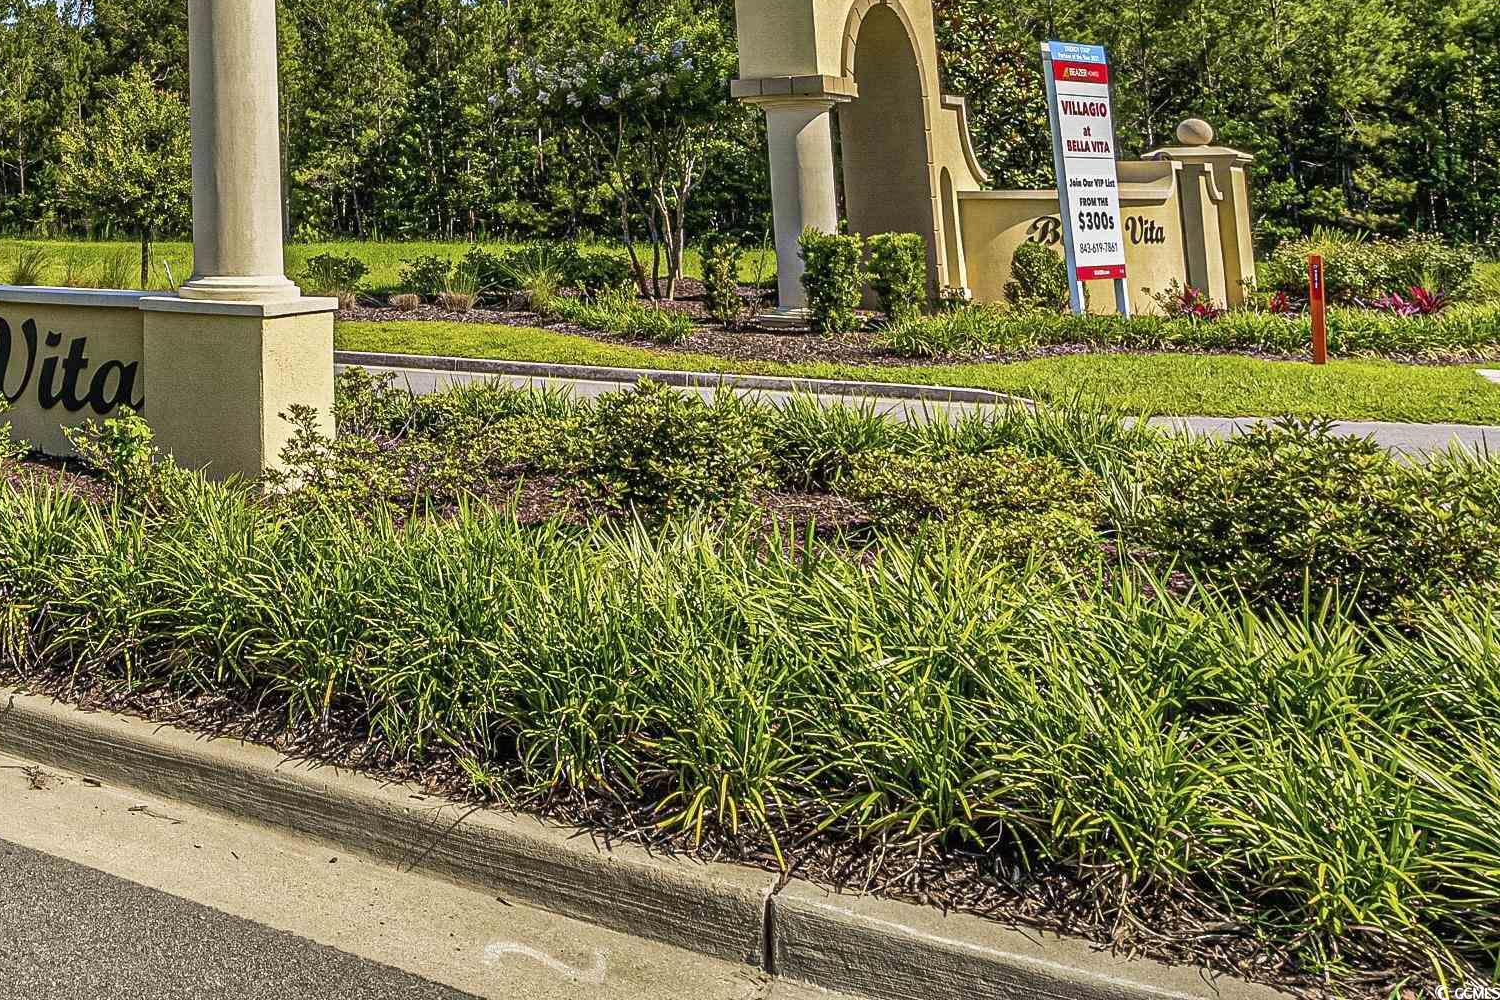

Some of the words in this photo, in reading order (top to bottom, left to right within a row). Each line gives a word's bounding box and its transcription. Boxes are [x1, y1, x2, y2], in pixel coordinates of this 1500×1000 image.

[1061, 100, 1107, 117] VILLAGIO
[1083, 126, 1091, 136] at
[1067, 140, 1090, 152] BELLA
[1091, 141, 1110, 153] VITA
[1070, 178, 1081, 187] Join
[1083, 179, 1093, 187] Our
[1094, 179, 1104, 187] VIP
[1105, 178, 1115, 187] List
[1080, 198, 1096, 206] FROM
[1097, 198, 1108, 206] THE
[1079, 211, 1114, 232] $300s
[1125, 216, 1165, 244] Vita
[1080, 243, 1118, 254] 843-619-7861
